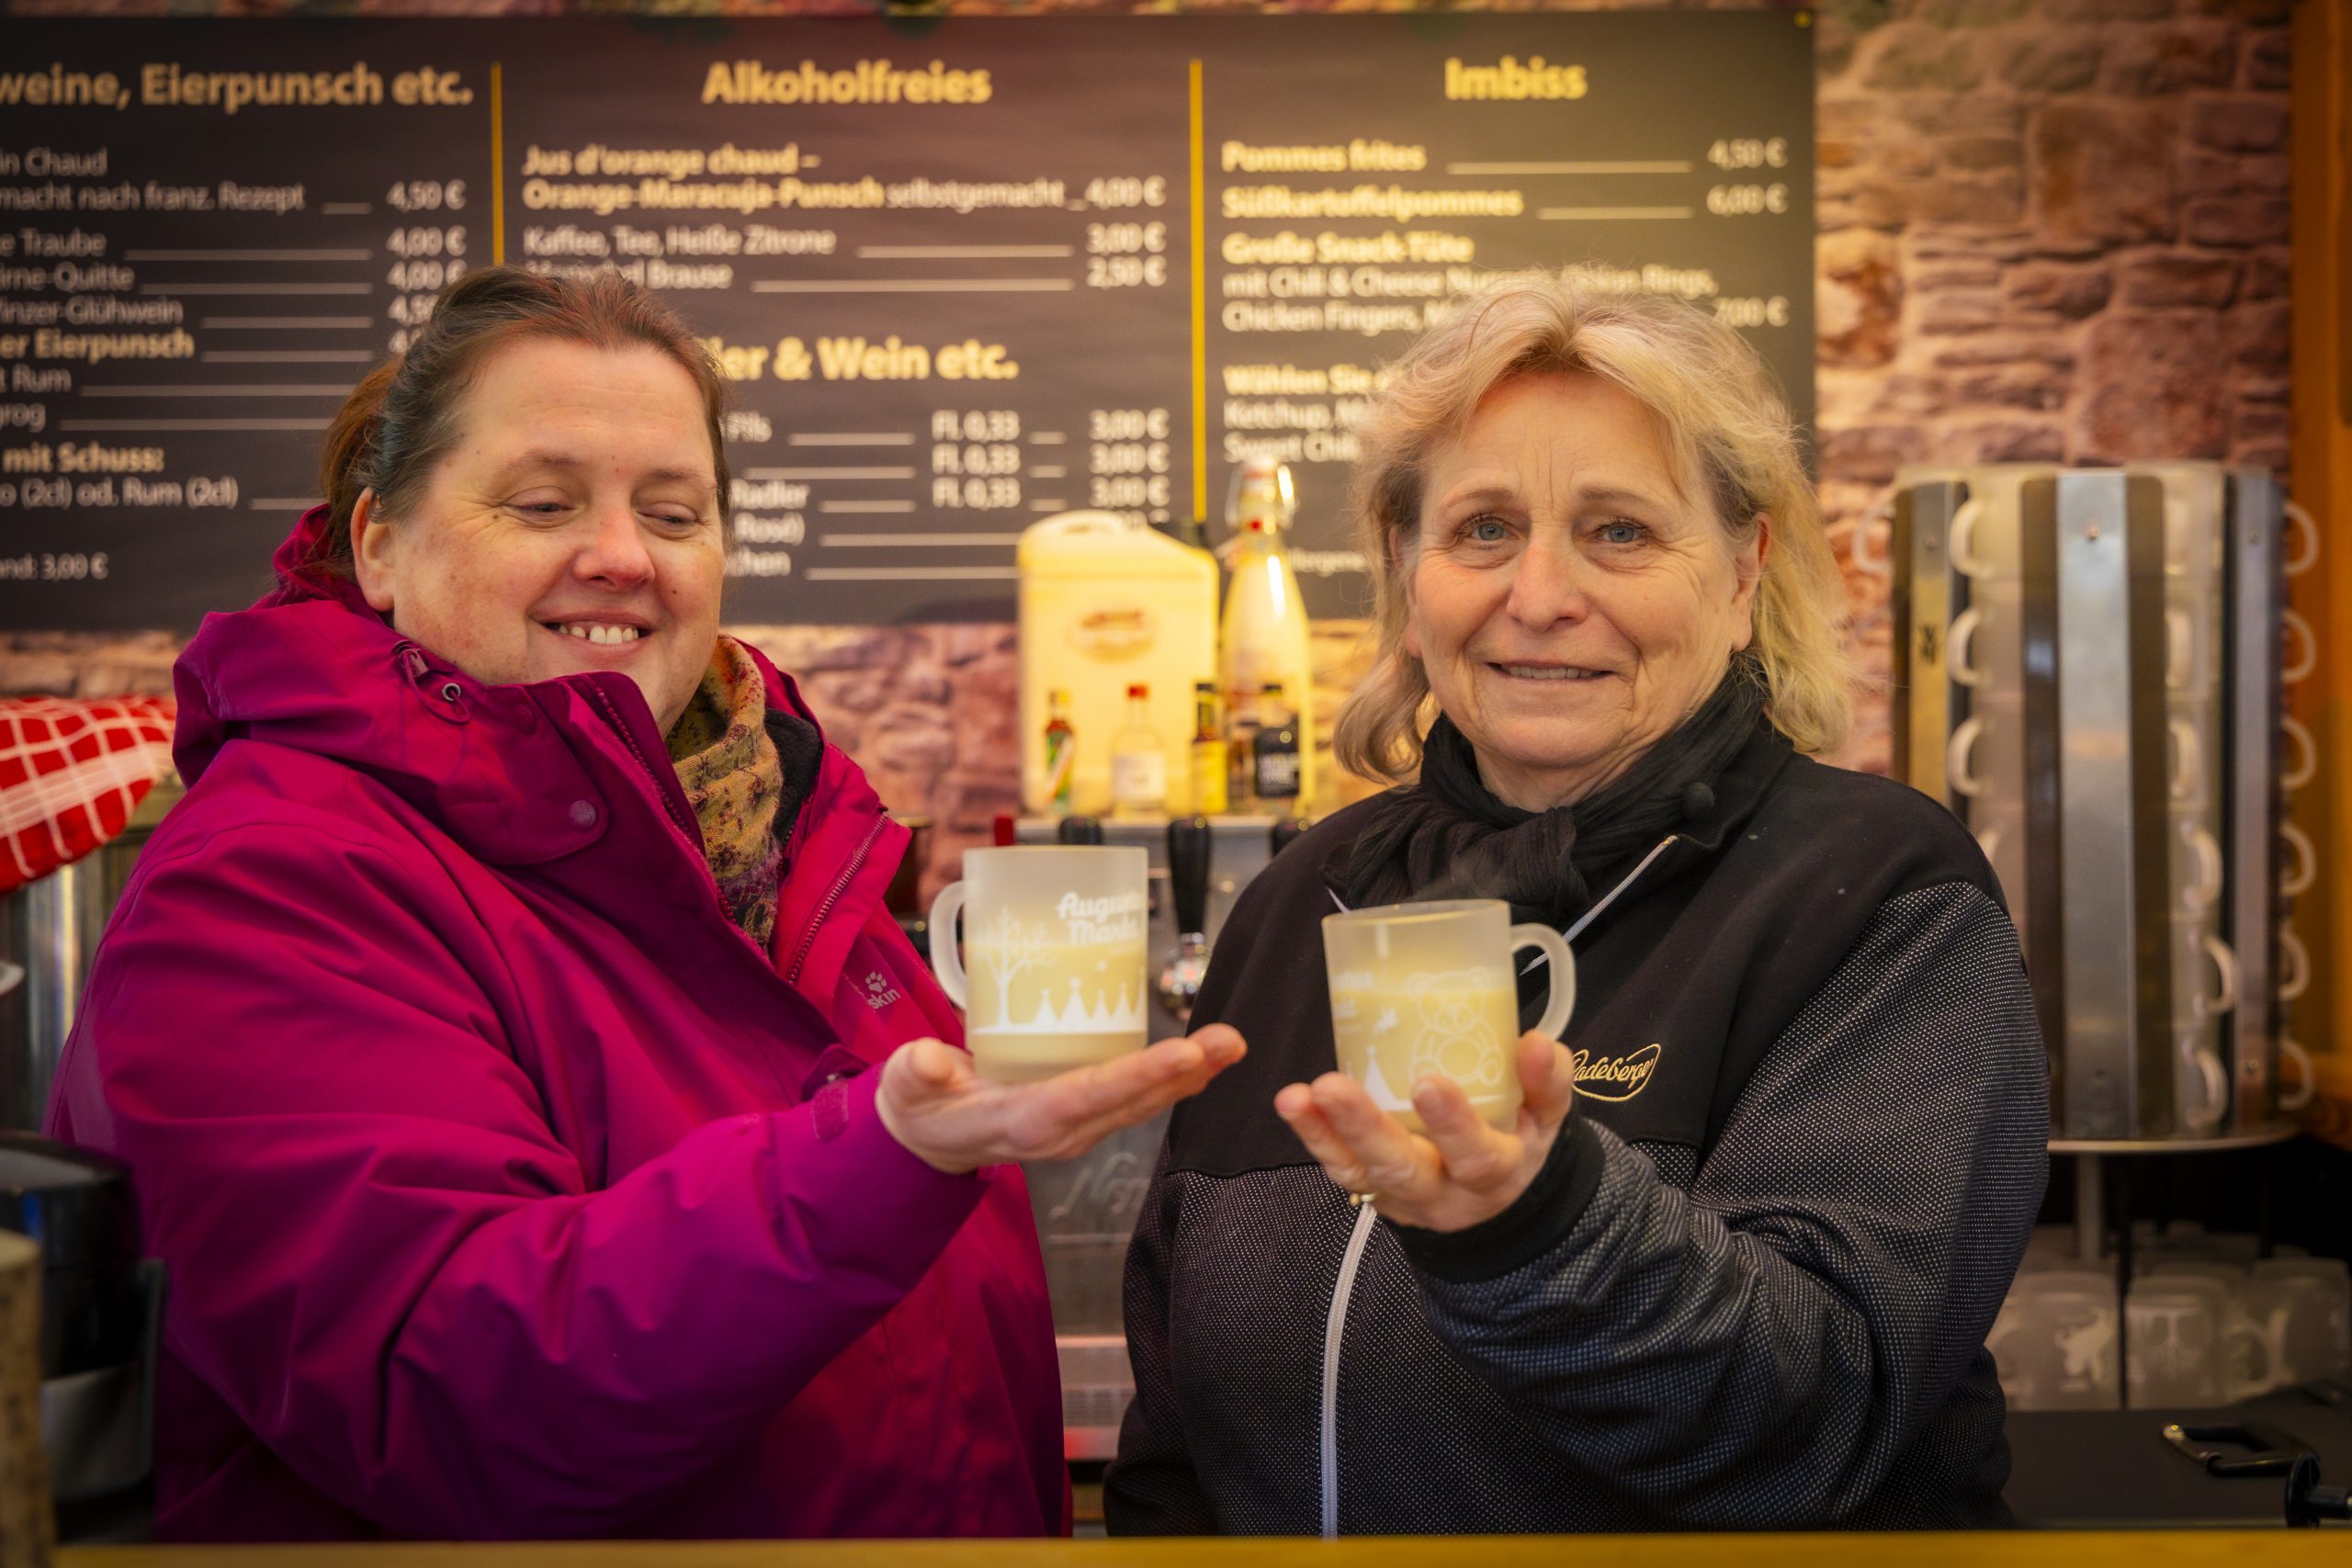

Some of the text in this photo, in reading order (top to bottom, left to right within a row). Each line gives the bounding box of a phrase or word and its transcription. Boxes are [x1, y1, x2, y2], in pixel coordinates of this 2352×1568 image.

[141, 62, 383, 115] Eierpunsch
[391, 66, 474, 107] etc.
[701, 59, 993, 105] Alkoholfreies
[1445, 54, 1589, 100] Imbiss
[24, 147, 108, 177] Chaud
[522, 144, 572, 175] Jus
[707, 142, 798, 175] chaud
[1221, 141, 1348, 172] Pommes
[1349, 138, 1427, 171] frites
[1707, 139, 1764, 172] 4,50
[78, 181, 141, 210] nach
[144, 179, 215, 211] franz.
[218, 180, 307, 217] Rezept
[386, 180, 443, 212] 4,50
[445, 178, 467, 211] €
[522, 177, 885, 215] Orange-Maracuja-Punsch
[886, 175, 1065, 213] selbstgemacht
[1085, 176, 1142, 210] 4,00
[1221, 184, 1524, 222] Süßkartoffelpommes
[1707, 184, 1764, 218] 6,00
[19, 227, 107, 257] Traube
[386, 227, 443, 259] 4,00
[446, 225, 468, 256] €
[524, 225, 610, 257] Kaffee,
[612, 226, 664, 256] Tee,
[666, 224, 742, 255] Heiße
[743, 225, 837, 255] Zitrone
[1086, 222, 1142, 256] 3,00
[1222, 231, 1315, 265] Große
[386, 260, 444, 293] 4,00
[646, 258, 733, 288] Brause
[1223, 268, 1267, 299] mit
[1268, 266, 1327, 298] Chili
[1351, 265, 1446, 298] Cheese
[1642, 264, 1720, 300] Rings,
[1222, 300, 1324, 333] Chicken
[1325, 299, 1423, 337] Fingers,
[34, 327, 195, 365] Eierpunsch
[773, 336, 813, 380] &
[816, 336, 930, 380] Wein
[935, 340, 1019, 380] etc.
[12, 364, 72, 393] Rum
[1223, 364, 1329, 395] Wählen
[1329, 364, 1373, 395] Sie
[1224, 398, 1334, 434] Ketchup,
[3, 441, 164, 473] mit Schuss:
[76, 477, 119, 507] od.
[122, 478, 183, 507] Rum
[40, 553, 88, 581] 3,00
